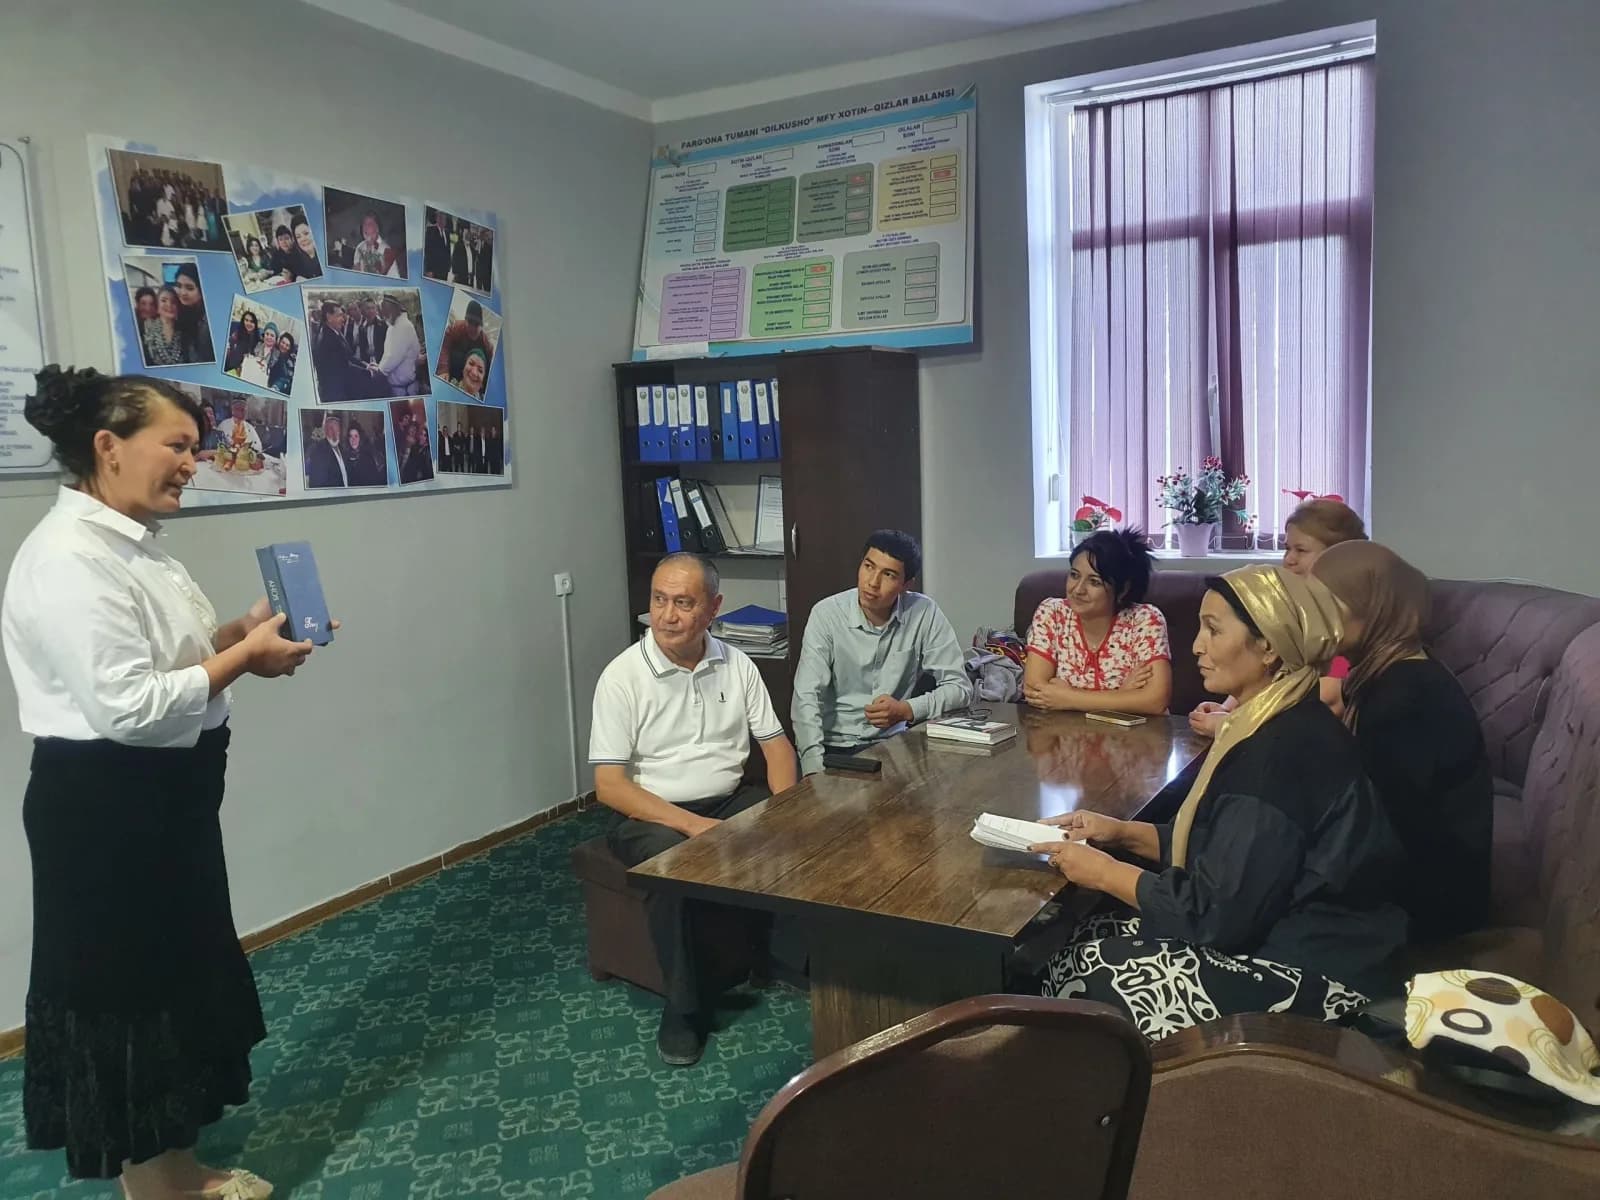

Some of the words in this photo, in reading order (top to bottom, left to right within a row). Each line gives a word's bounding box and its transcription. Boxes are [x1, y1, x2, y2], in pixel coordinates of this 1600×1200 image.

[724, 128, 759, 142] TUMANI
[816, 112, 836, 123] MFY
[911, 88, 955, 104] BALANSI
